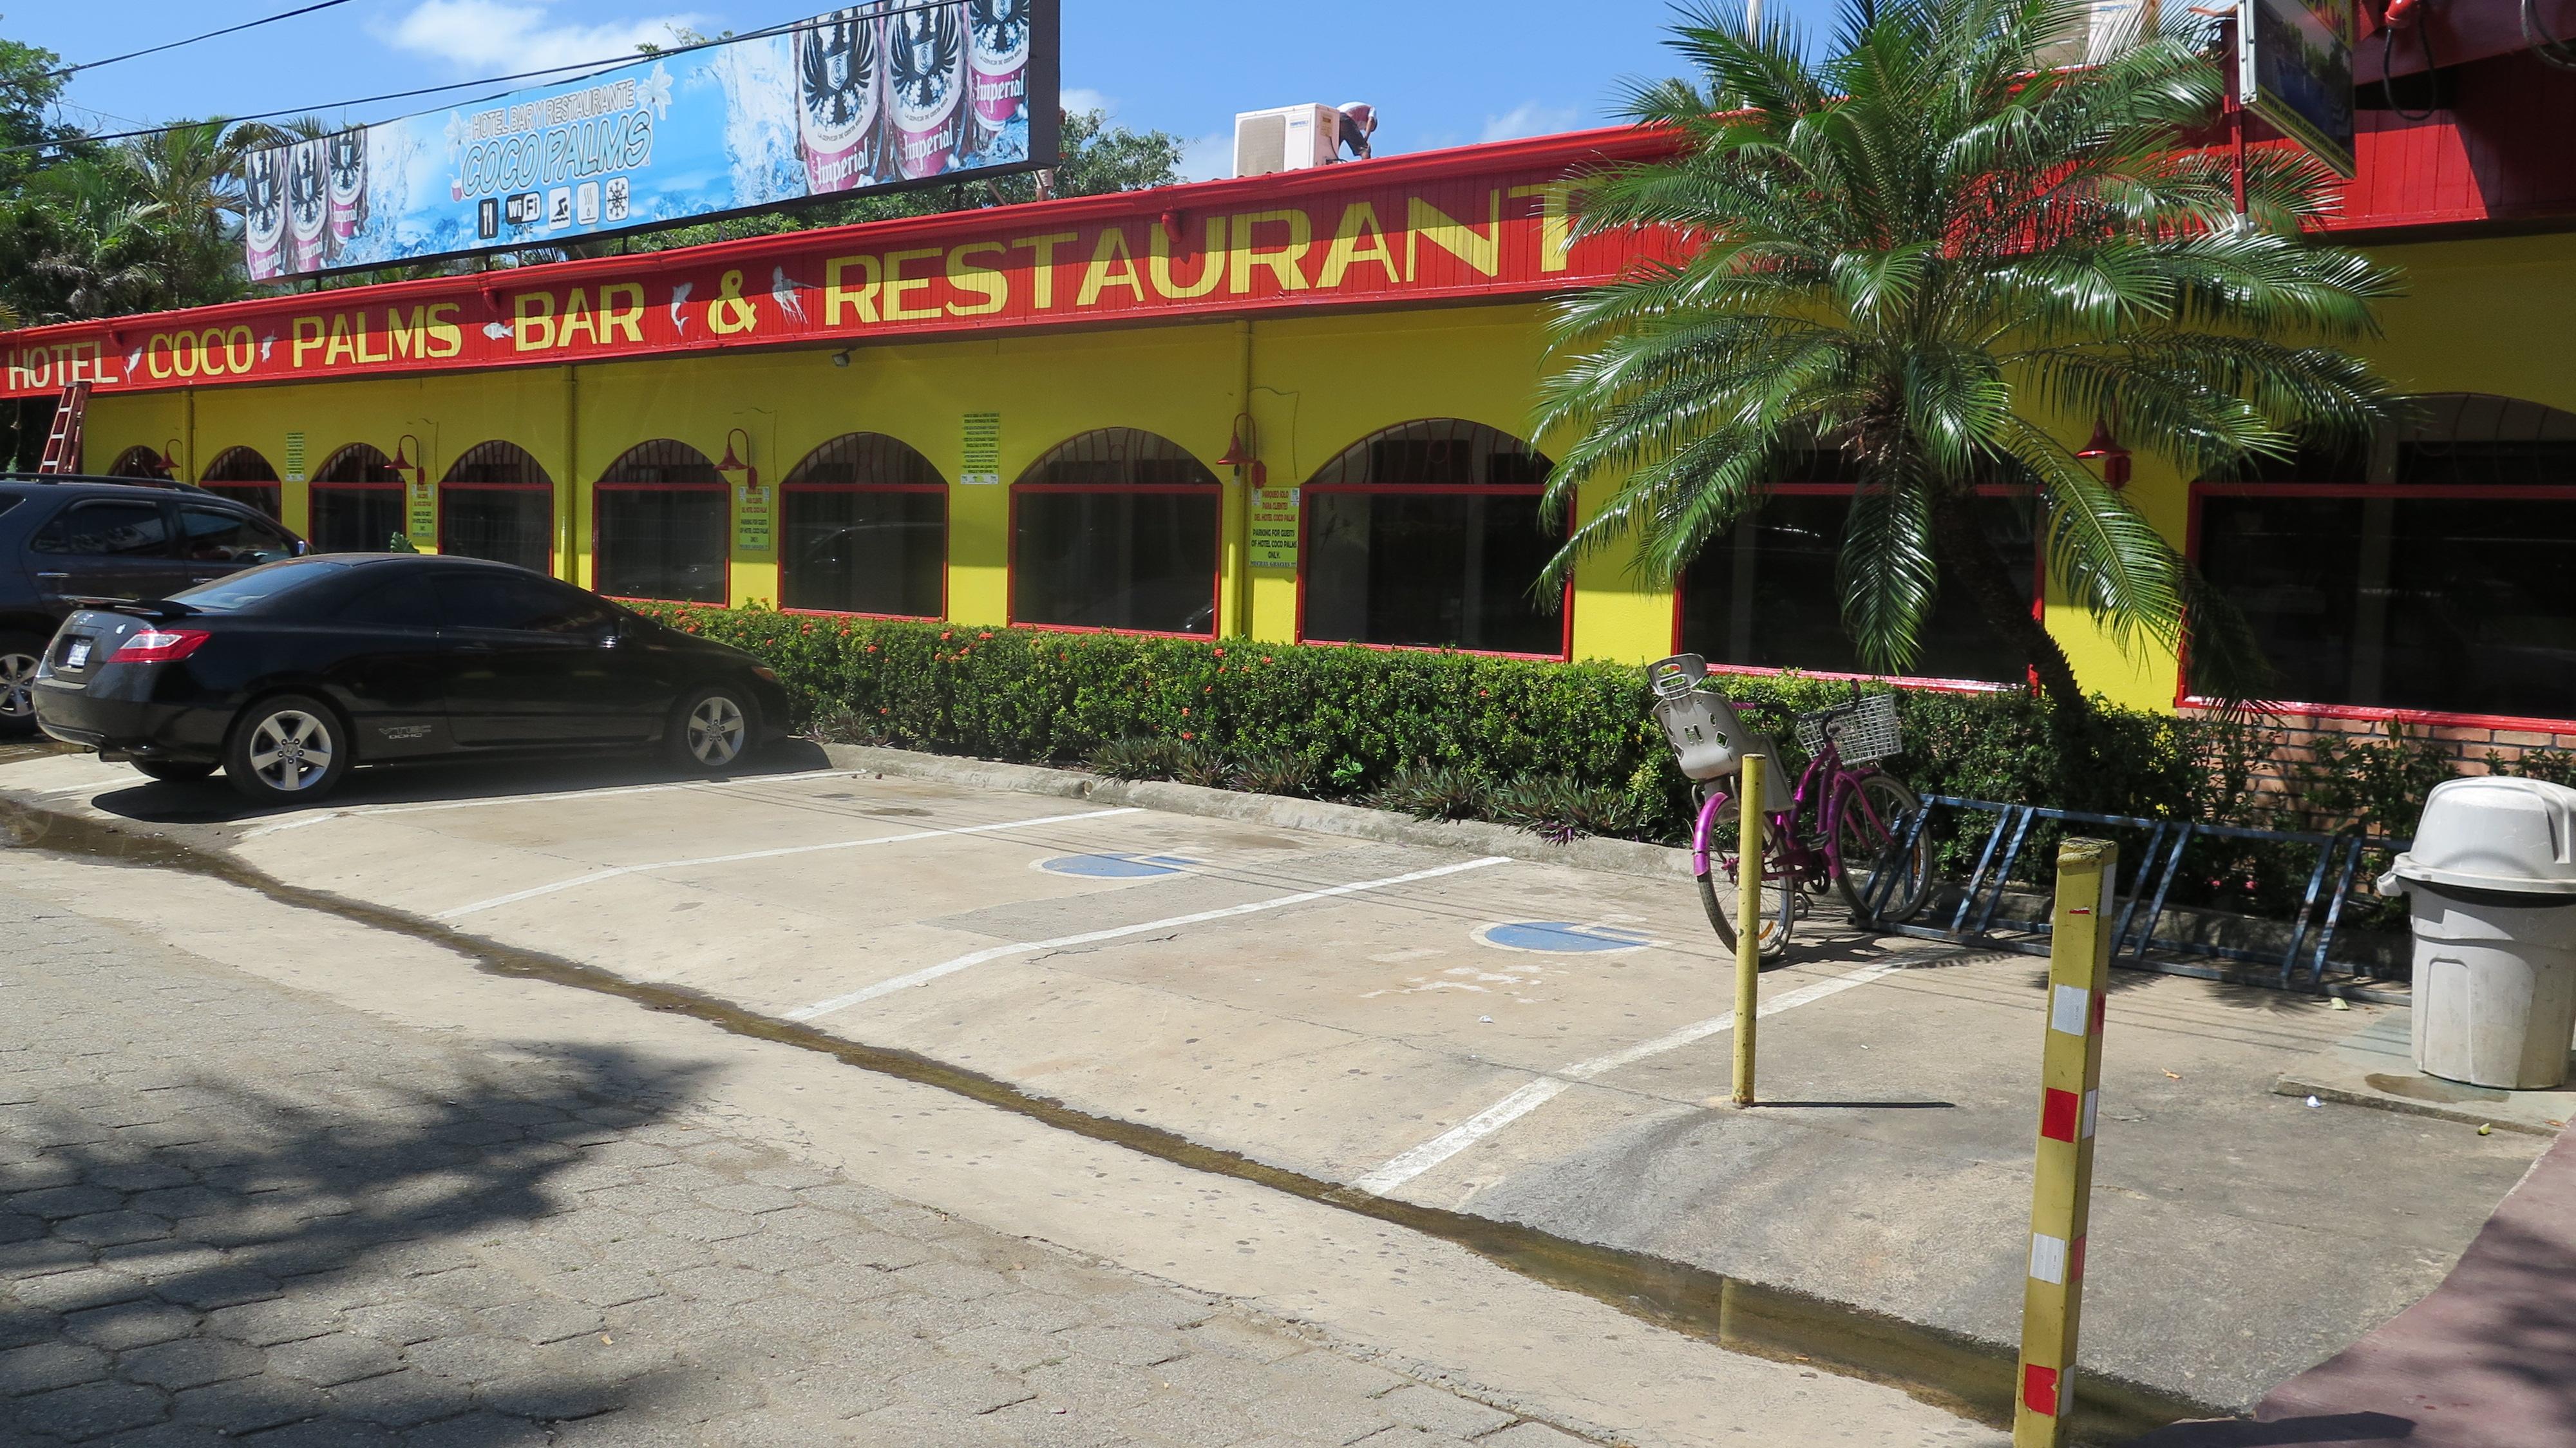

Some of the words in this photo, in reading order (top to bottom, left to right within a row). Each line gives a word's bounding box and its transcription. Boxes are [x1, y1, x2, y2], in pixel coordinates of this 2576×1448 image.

[472, 109, 509, 140] HOTEL
[510, 104, 533, 133] BAR
[532, 100, 545, 129] Y
[546, 80, 635, 124] RESTAURANTE
[975, 68, 1025, 114] Imperial
[462, 133, 540, 196] COCO
[543, 110, 651, 183] PALMS
[816, 137, 869, 191] Imperial
[904, 117, 954, 171] Imperial
[513, 223, 533, 236] ZONE
[8, 341, 118, 390] HOTEL
[147, 325, 255, 379] COCO
[292, 302, 462, 368] PALMS
[515, 280, 645, 352] BAR
[707, 269, 758, 334] &
[825, 174, 1607, 327] RESTAURANT
[1271, 540, 1283, 548] COCO
